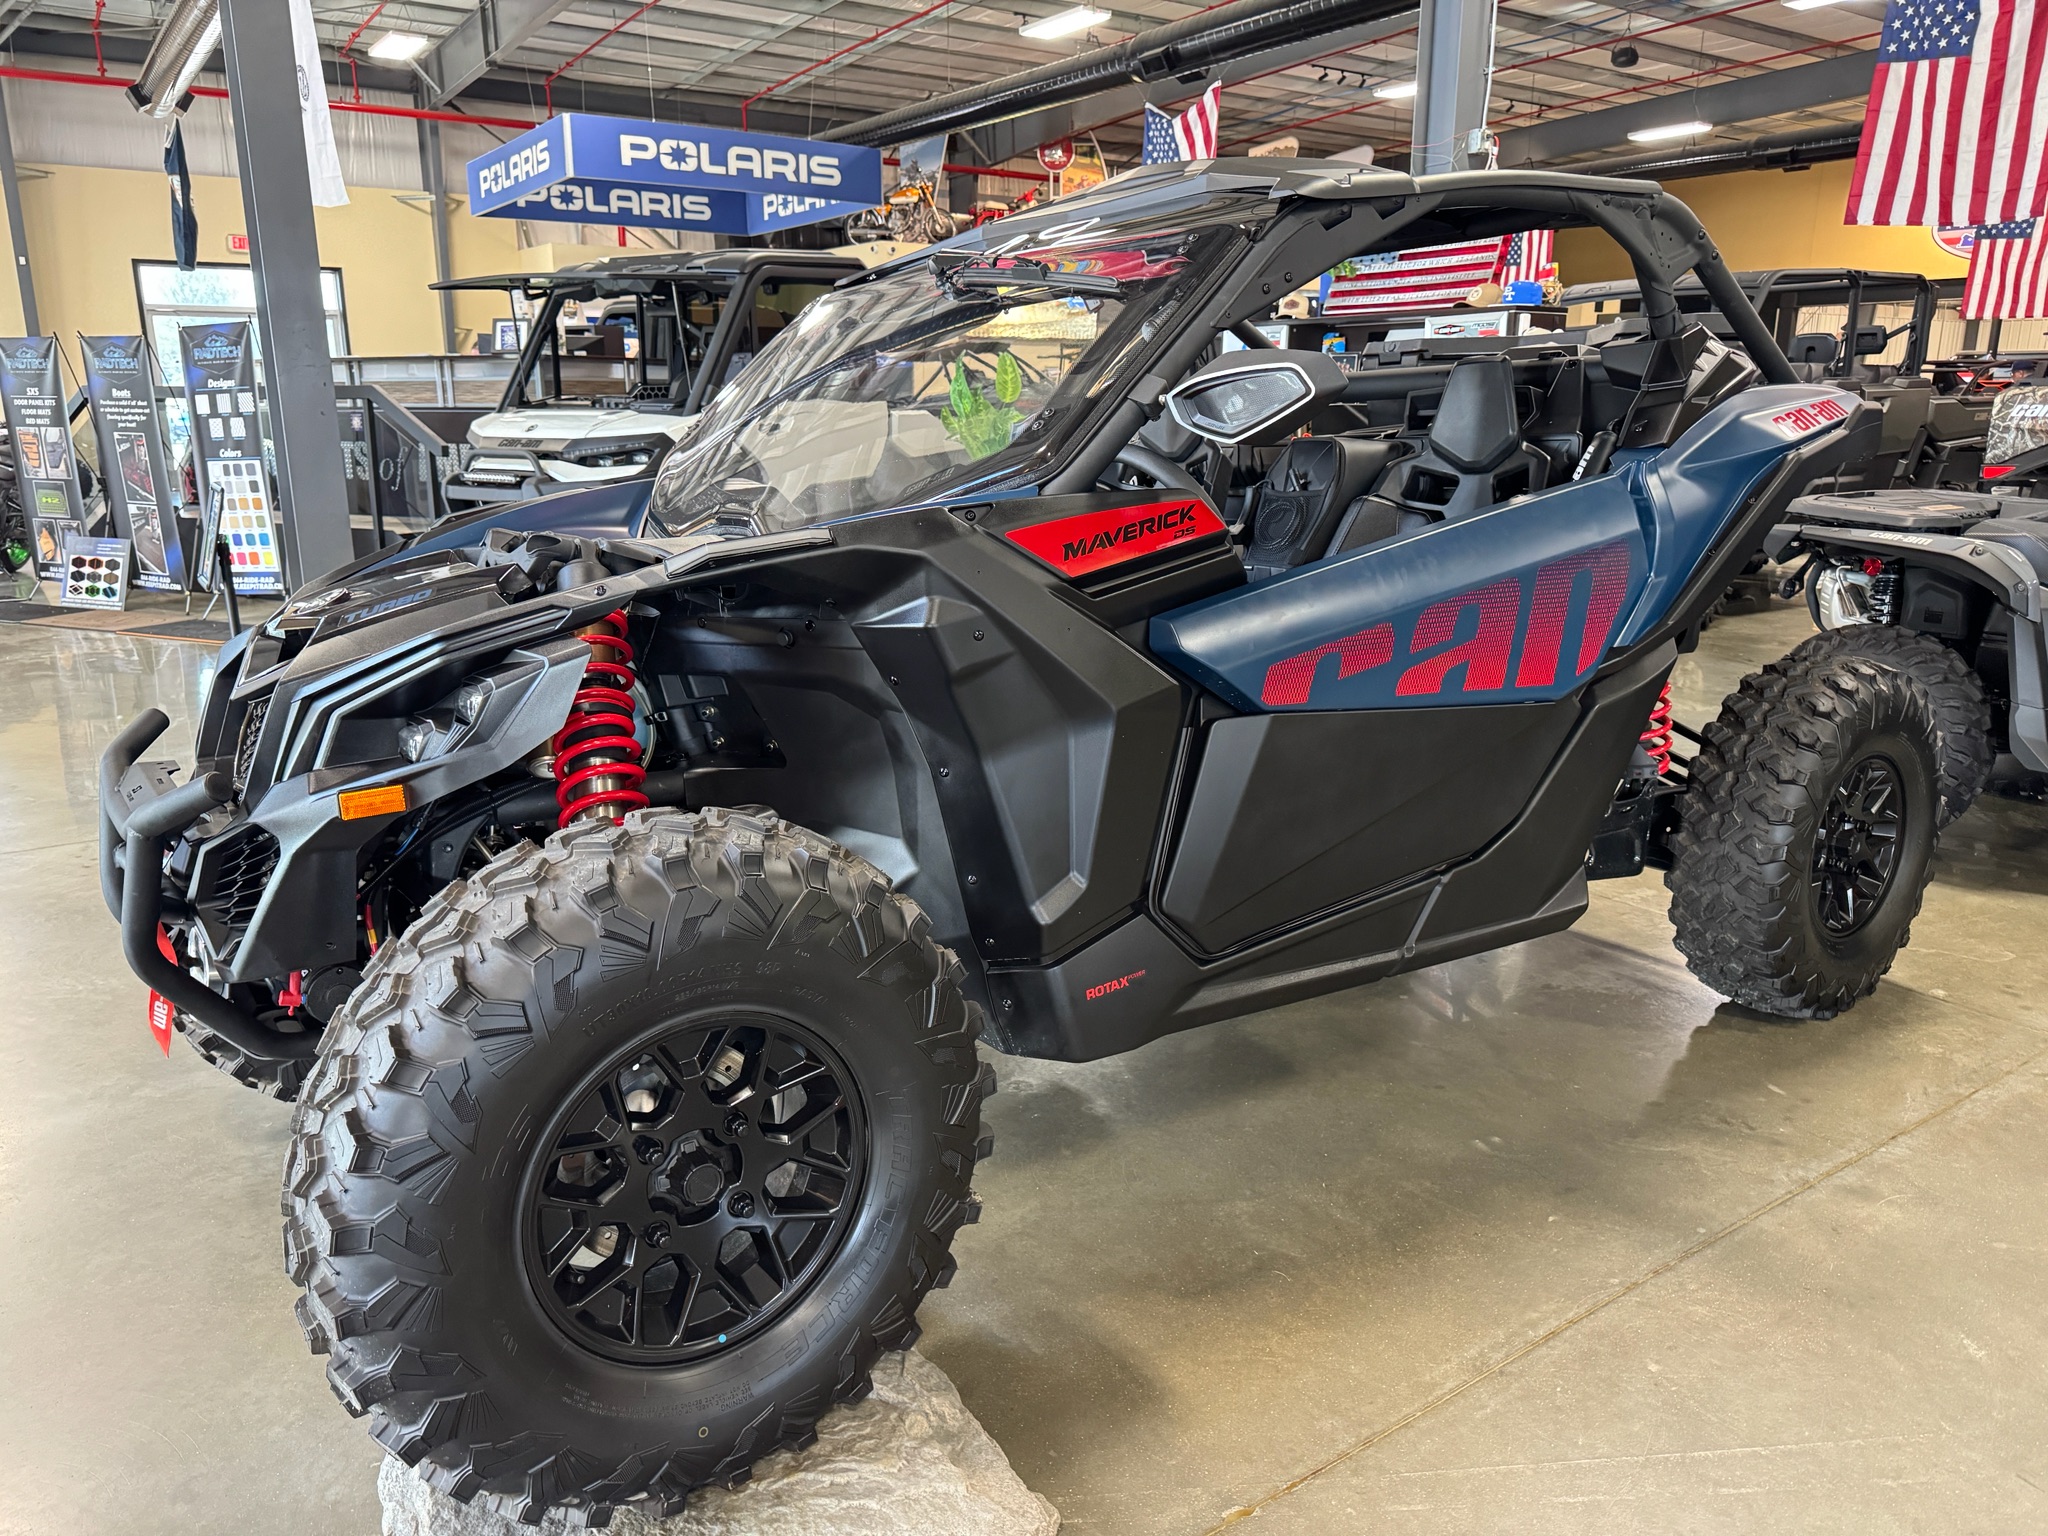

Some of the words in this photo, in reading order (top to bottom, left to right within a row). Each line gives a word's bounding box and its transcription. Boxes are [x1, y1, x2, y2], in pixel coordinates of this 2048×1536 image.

[478, 138, 550, 198] POLARIS
[619, 133, 842, 187] POLARIS
[112, 388, 131, 397] Boats
[207, 378, 235, 389] Designs
[1772, 399, 1850, 438] can-am
[219, 448, 242, 458] Colors
[498, 438, 543, 448] can-am
[379, 446, 408, 491] of
[1061, 503, 1197, 562] MAVERICK
[1173, 526, 1196, 540] DS
[1868, 532, 1934, 546] can-am
[344, 588, 433, 623] TURBO
[1085, 976, 1130, 1001] ROTAX
